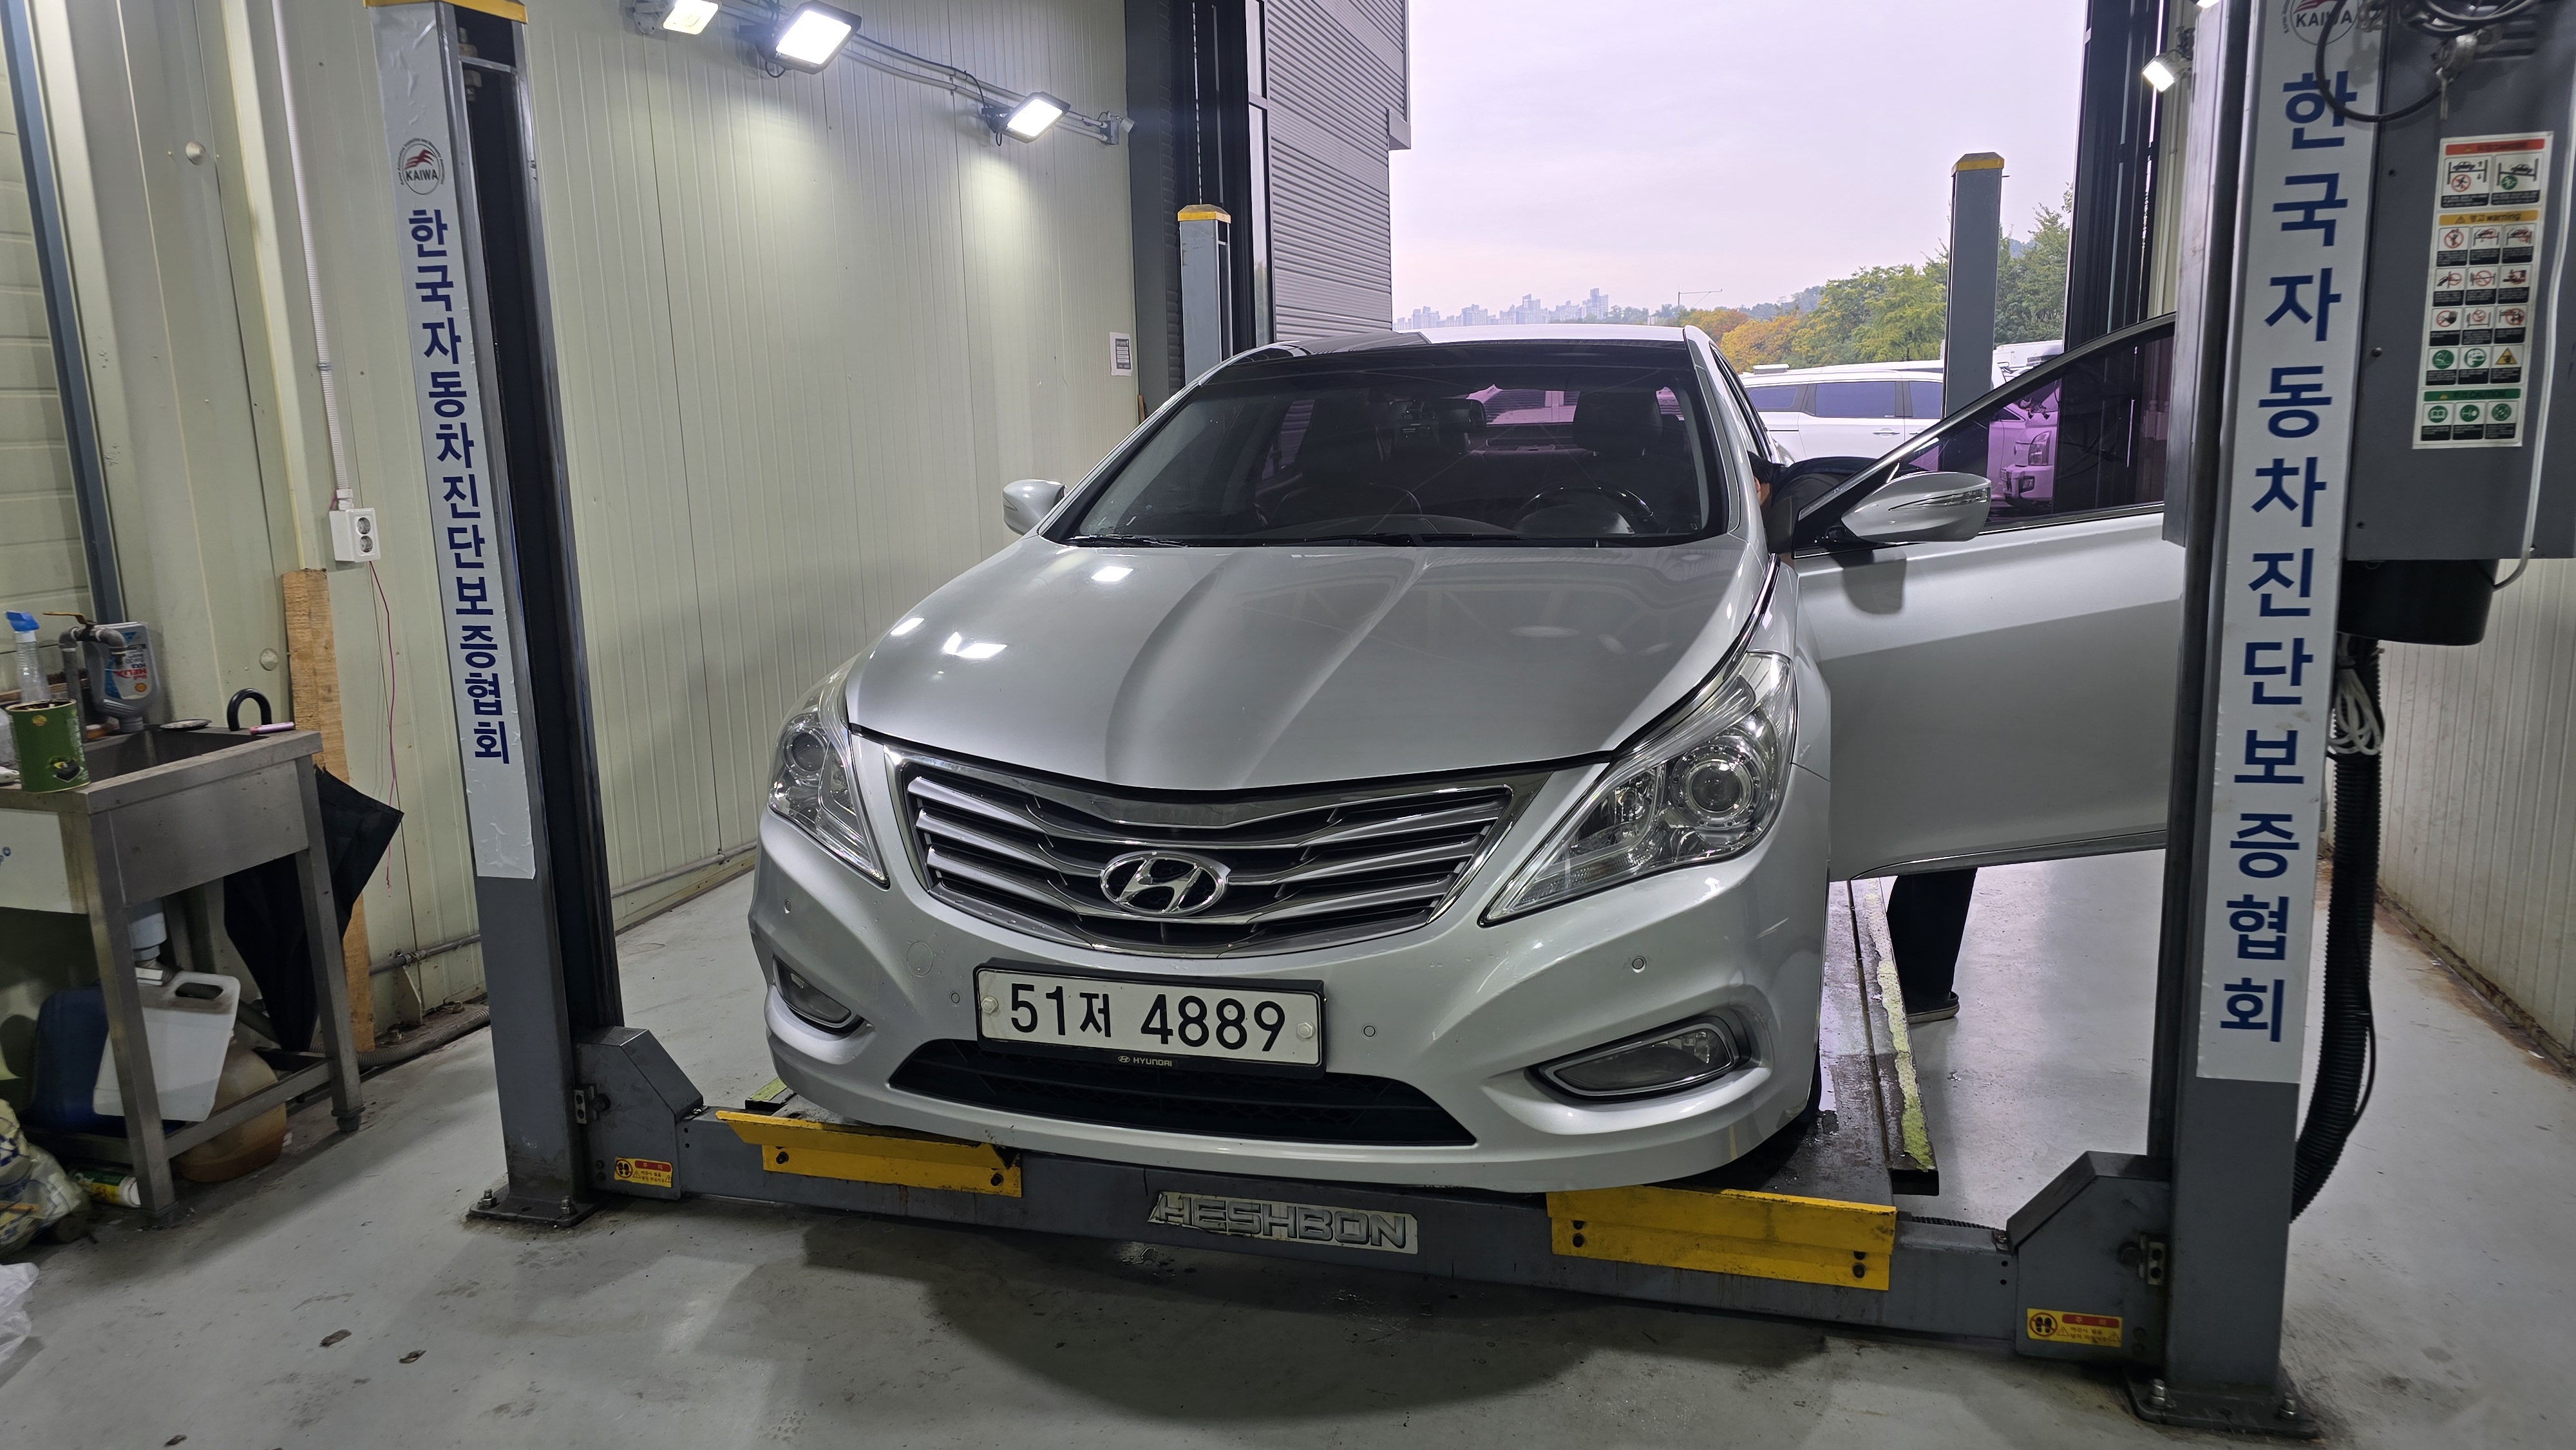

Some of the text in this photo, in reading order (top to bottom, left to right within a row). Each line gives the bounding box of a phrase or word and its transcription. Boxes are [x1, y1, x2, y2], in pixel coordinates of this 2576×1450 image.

[405, 169, 439, 182] KAIWA
[408, 209, 509, 765] 한국자동차진단보증협회
[2219, 70, 2358, 1043] 한국자동차진단보증협회
[1010, 983, 1285, 1052] 51저 4889
[1133, 1057, 1172, 1067] HYUNDAI
[1159, 1193, 1407, 1250] HESHBON
